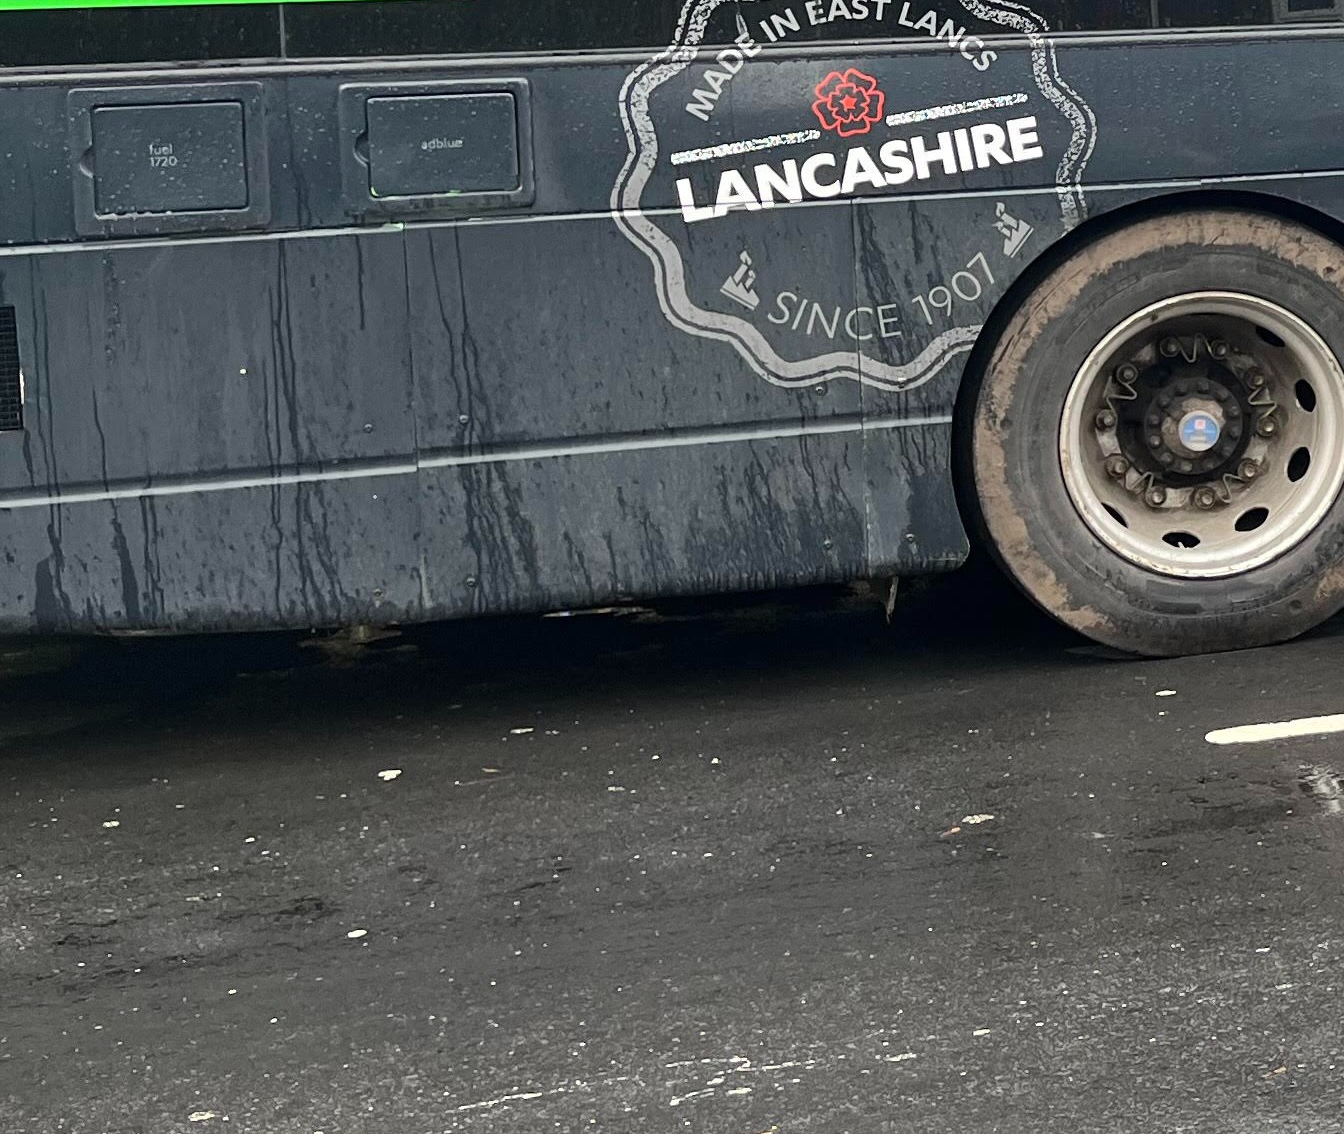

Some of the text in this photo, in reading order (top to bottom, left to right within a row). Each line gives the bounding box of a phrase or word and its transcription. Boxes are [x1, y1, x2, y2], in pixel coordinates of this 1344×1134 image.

[685, 32, 762, 122] MADE
[758, 7, 801, 42] IN
[898, 2, 998, 72] LANCS
[149, 142, 173, 155] fuel
[150, 156, 178, 167] 1720
[676, 115, 1044, 223] LANCASHIRE
[767, 252, 995, 341] SINCE 1907
